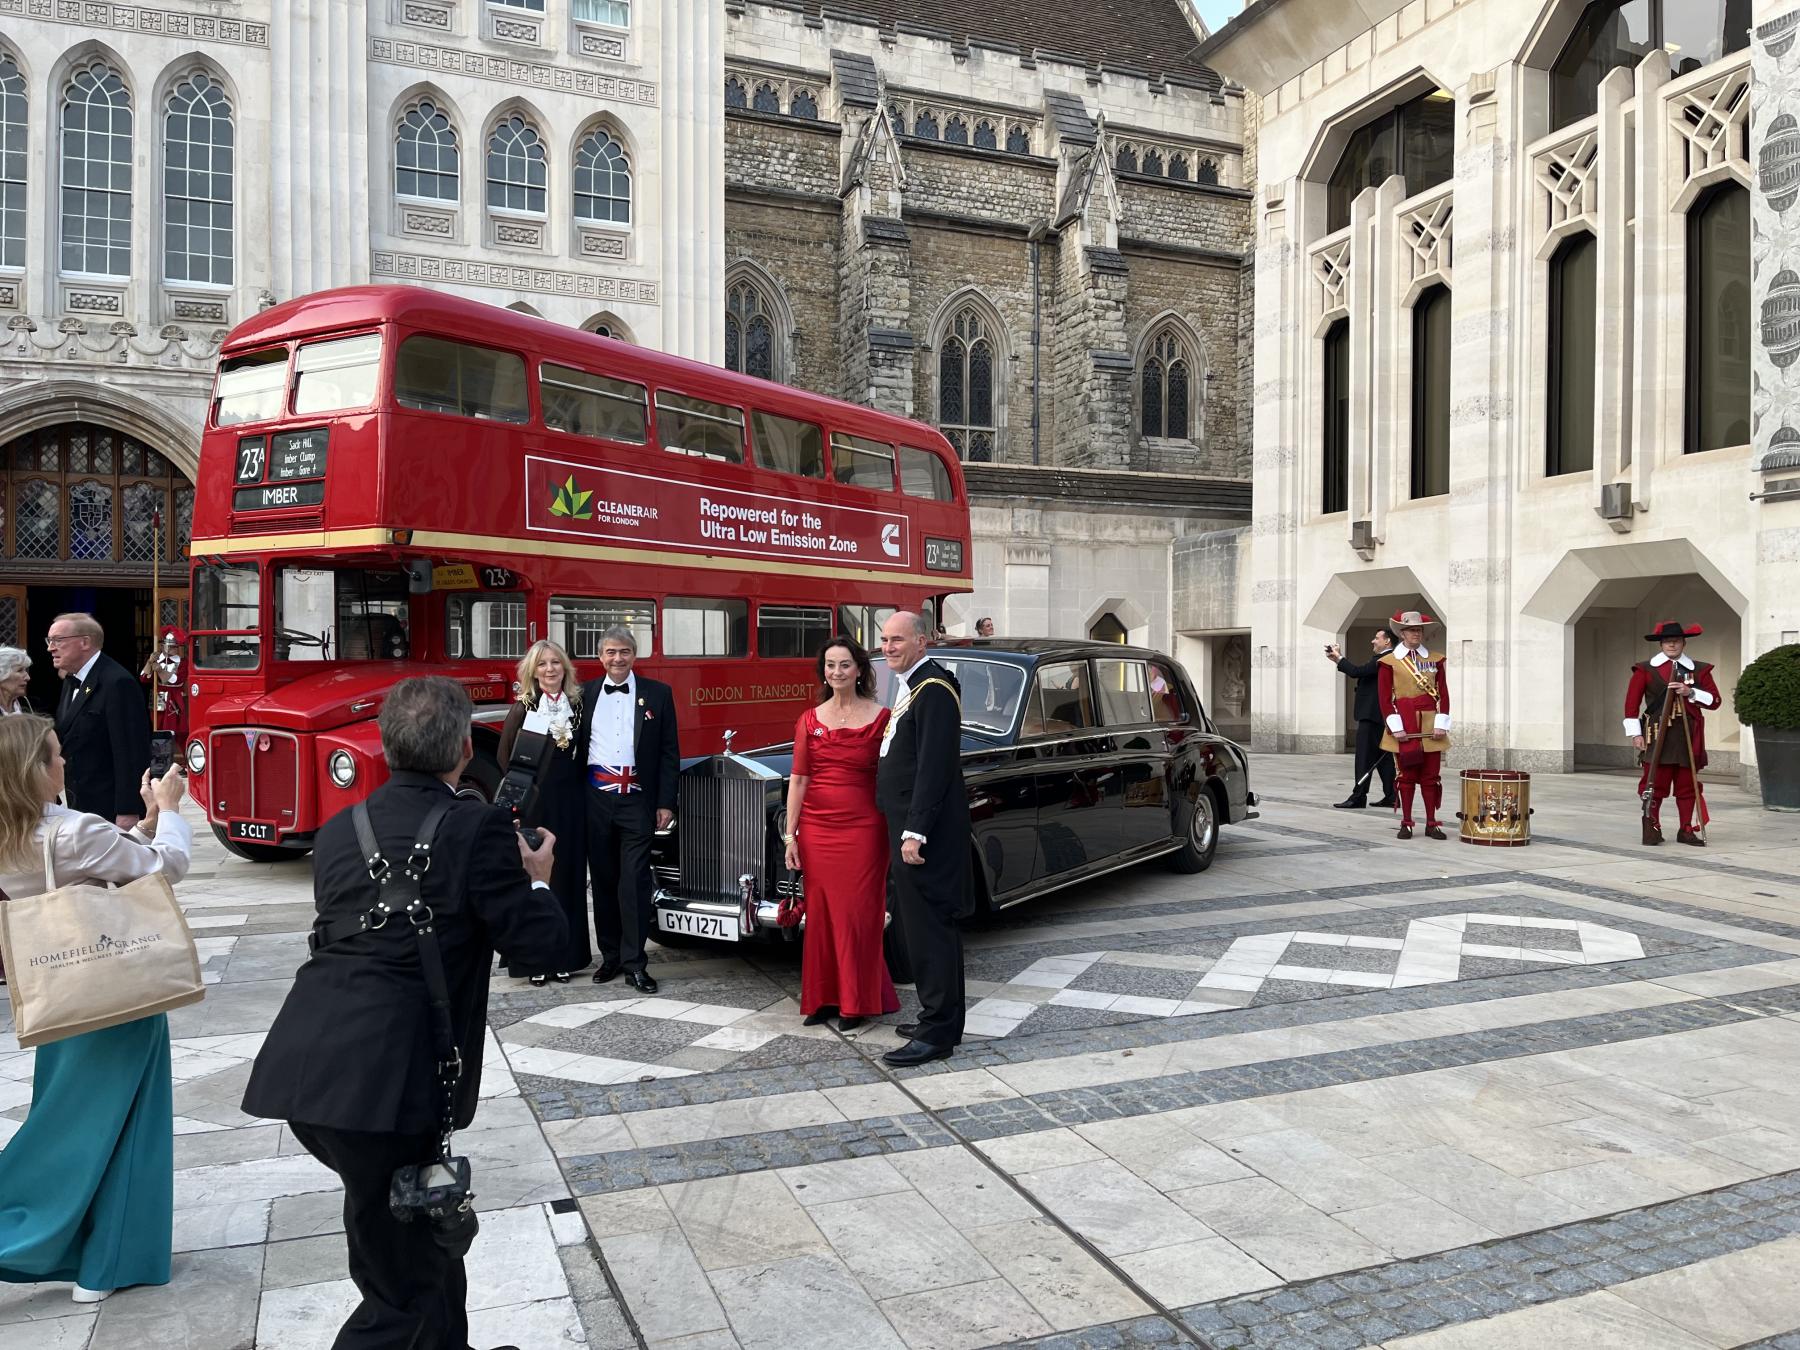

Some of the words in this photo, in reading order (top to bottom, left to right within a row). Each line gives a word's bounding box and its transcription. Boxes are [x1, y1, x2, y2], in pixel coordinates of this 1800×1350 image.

[262, 487, 298, 505] IMBER
[598, 514, 611, 523] FOR
[612, 516, 640, 526] LONDON
[699, 497, 777, 525] Repowered
[780, 509, 799, 527] for
[801, 512, 822, 530] the
[699, 519, 736, 541] Ultra
[739, 524, 768, 544] Low
[770, 528, 826, 550] Emission
[828, 535, 858, 553] Zone
[485, 567, 511, 586] 23A
[690, 686, 744, 706] LONDON
[749, 683, 815, 700] TRANSPORT
[240, 823, 247, 837] 5
[248, 825, 267, 839] CLT
[666, 912, 693, 932] GYY
[696, 916, 729, 937] 127L
[29, 943, 105, 967] HOMEFIELD
[114, 933, 161, 949] GRANGE
